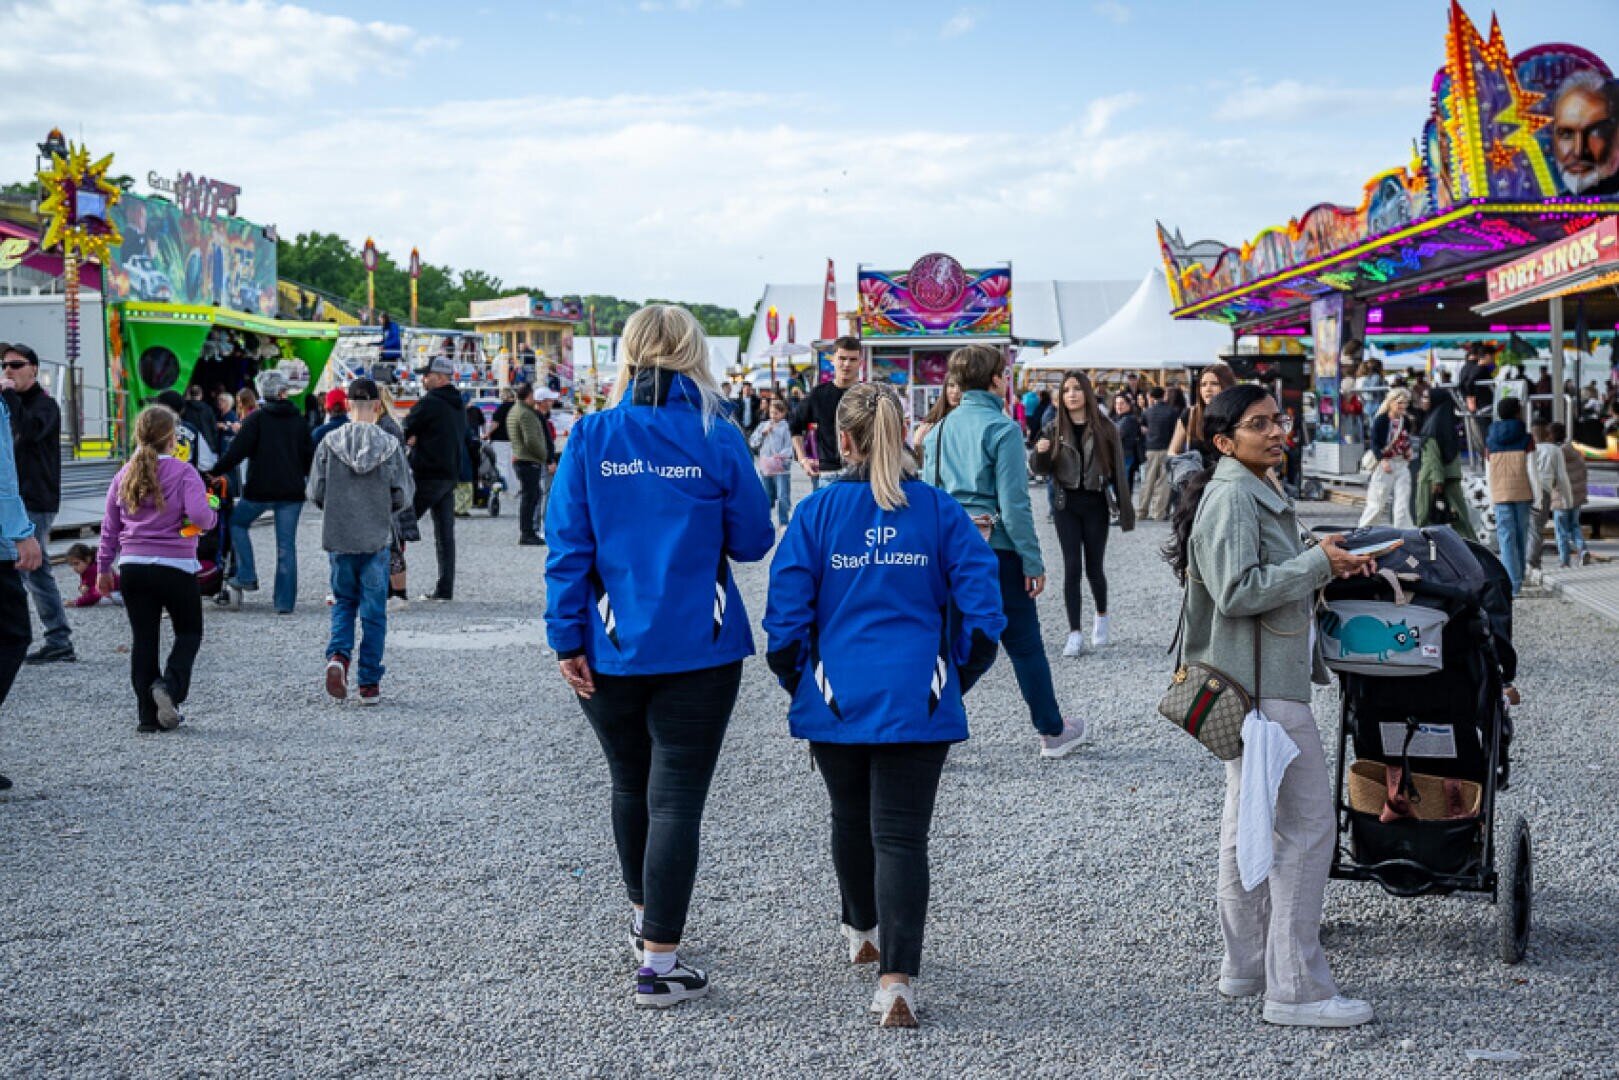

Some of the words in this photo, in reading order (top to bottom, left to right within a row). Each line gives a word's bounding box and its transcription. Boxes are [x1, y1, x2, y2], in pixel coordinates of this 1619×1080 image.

[601, 459, 645, 477] Stadt
[864, 526, 898, 547] SIP
[874, 548, 929, 567] Luzern
